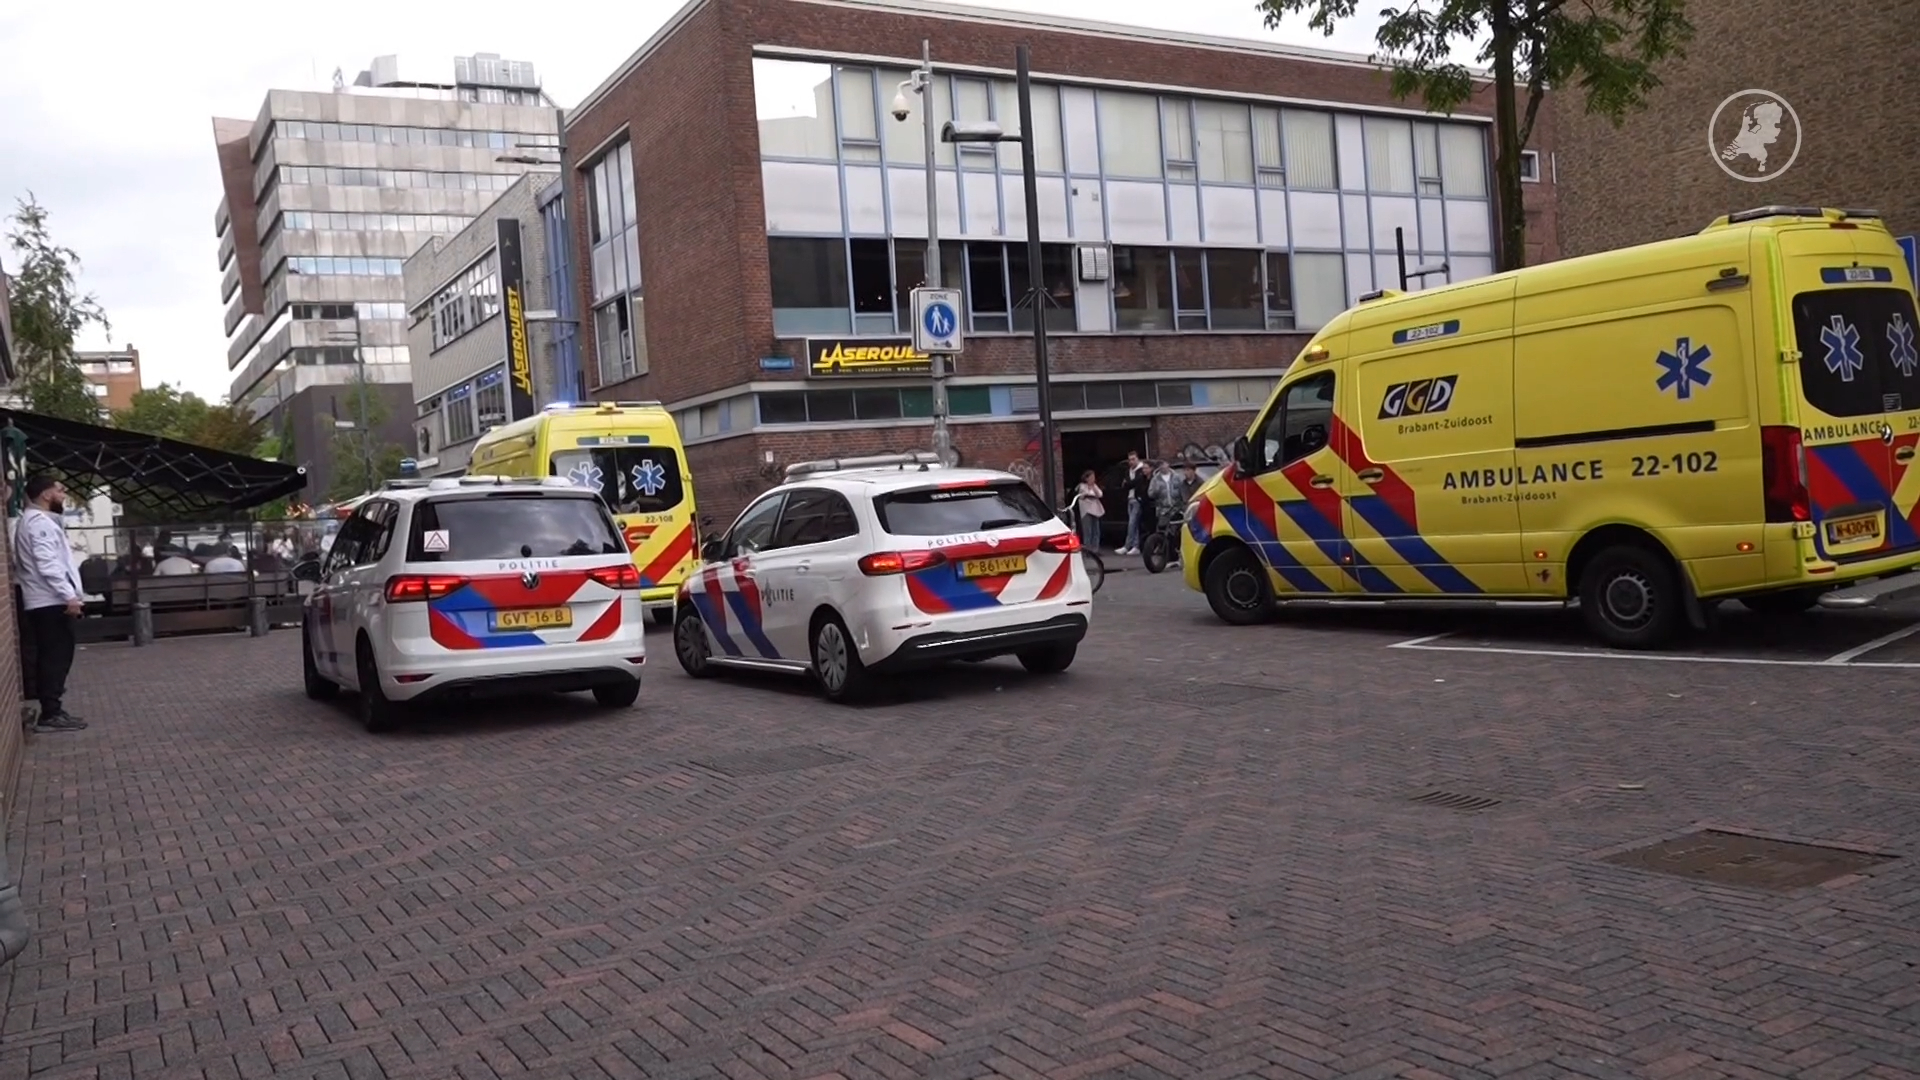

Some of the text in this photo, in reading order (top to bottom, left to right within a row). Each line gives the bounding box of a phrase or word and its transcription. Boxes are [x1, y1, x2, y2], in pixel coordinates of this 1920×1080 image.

[507, 284, 532, 396] LASERQUEST
[1411, 326, 1440, 339] 22-102
[820, 342, 930, 362] LASERQUE
[1383, 379, 1452, 415] GGD
[1398, 415, 1493, 435] Brabant-Zuidoost
[1804, 420, 1881, 441] AMBULANCE
[1443, 451, 1718, 490] AMBULANCE 22-102
[1461, 491, 1557, 505] Brabant-Zuidoost
[645, 515, 673, 523] 22-108
[927, 533, 979, 547] POLITIE
[498, 559, 559, 570] POLITIE
[967, 557, 1018, 574] P-861-VV
[502, 610, 564, 626] GVT-16-B
